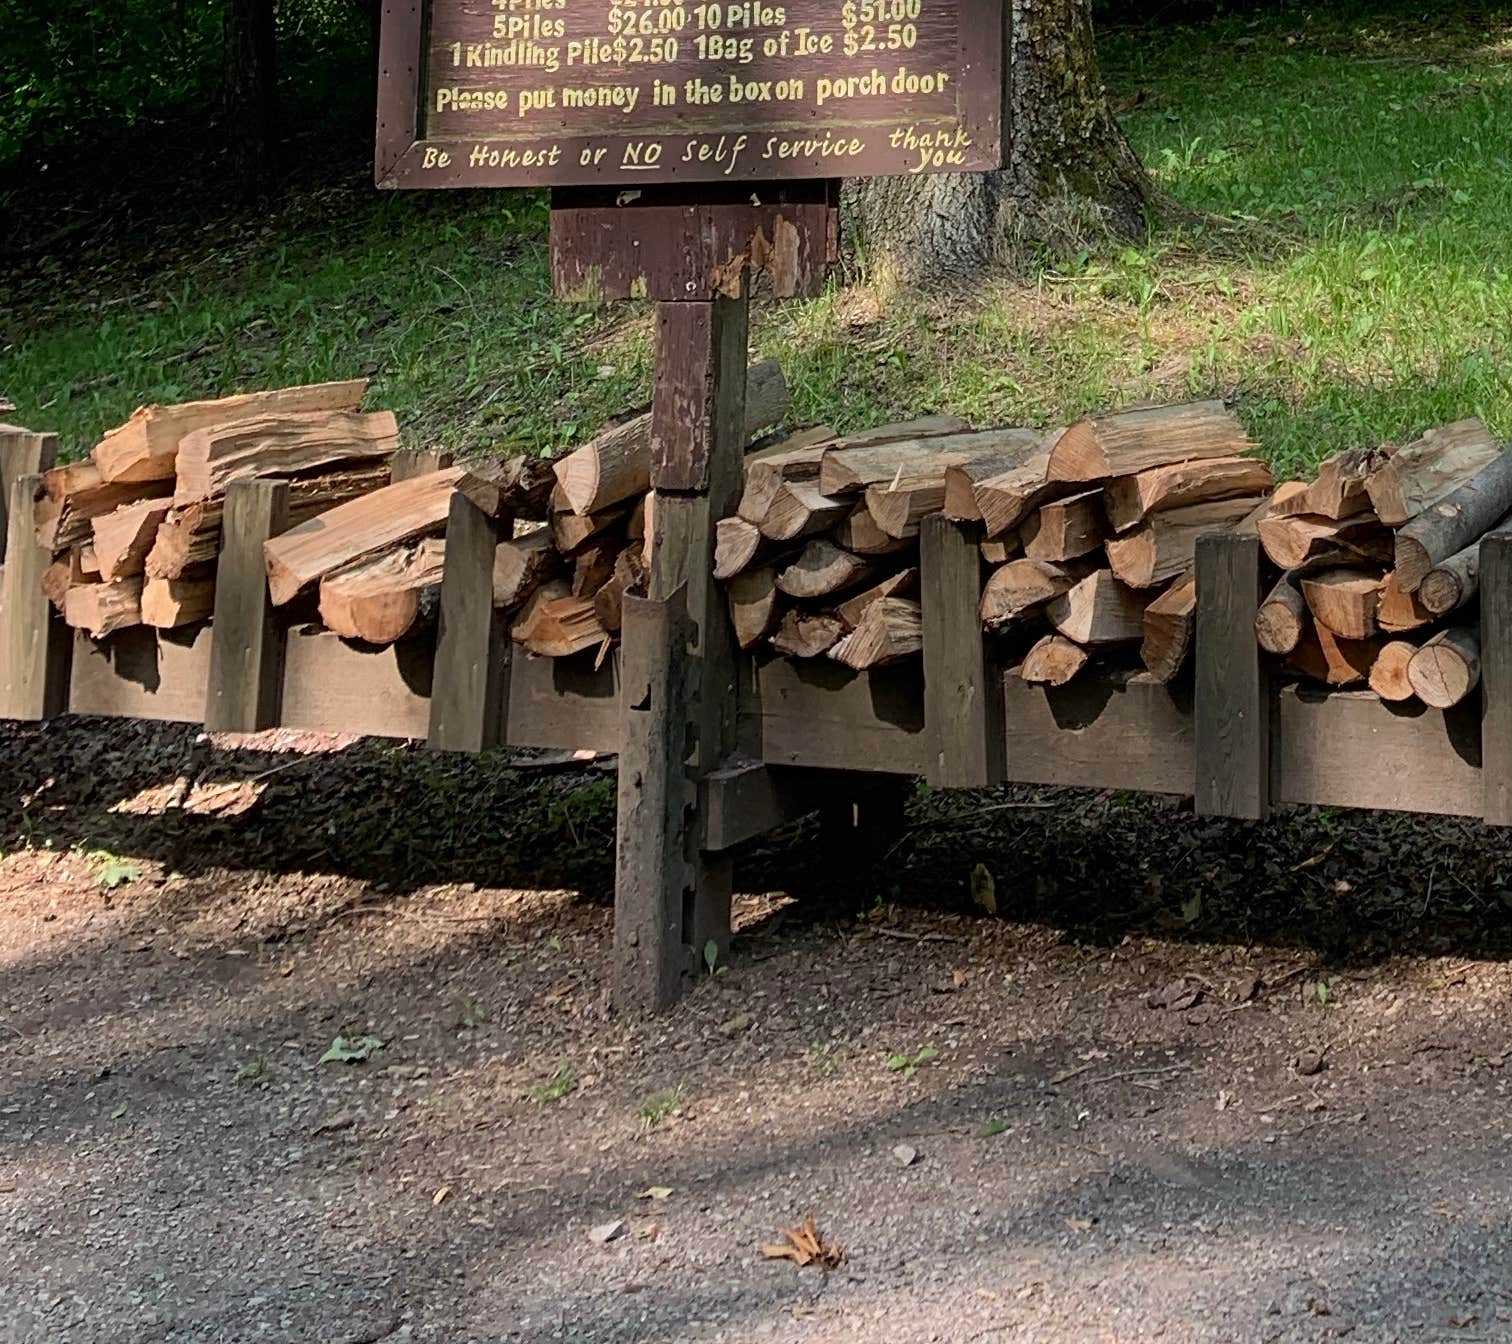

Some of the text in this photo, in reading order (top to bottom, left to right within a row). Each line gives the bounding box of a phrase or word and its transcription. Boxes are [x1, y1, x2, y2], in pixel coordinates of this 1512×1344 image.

[607, 6, 686, 35] $26.00
[567, 38, 612, 65] Pile
[612, 35, 678, 67] $2.50
[764, 30, 789, 56] of
[794, 28, 833, 56] Ice
[843, 23, 917, 57] $2.50
[436, 67, 949, 117] Please put money in the box on porch door
[888, 126, 972, 150] thank
[422, 146, 451, 168] Be
[469, 144, 562, 168] Honest
[580, 147, 607, 166] or
[622, 141, 662, 165] NO
[909, 147, 966, 173] you
